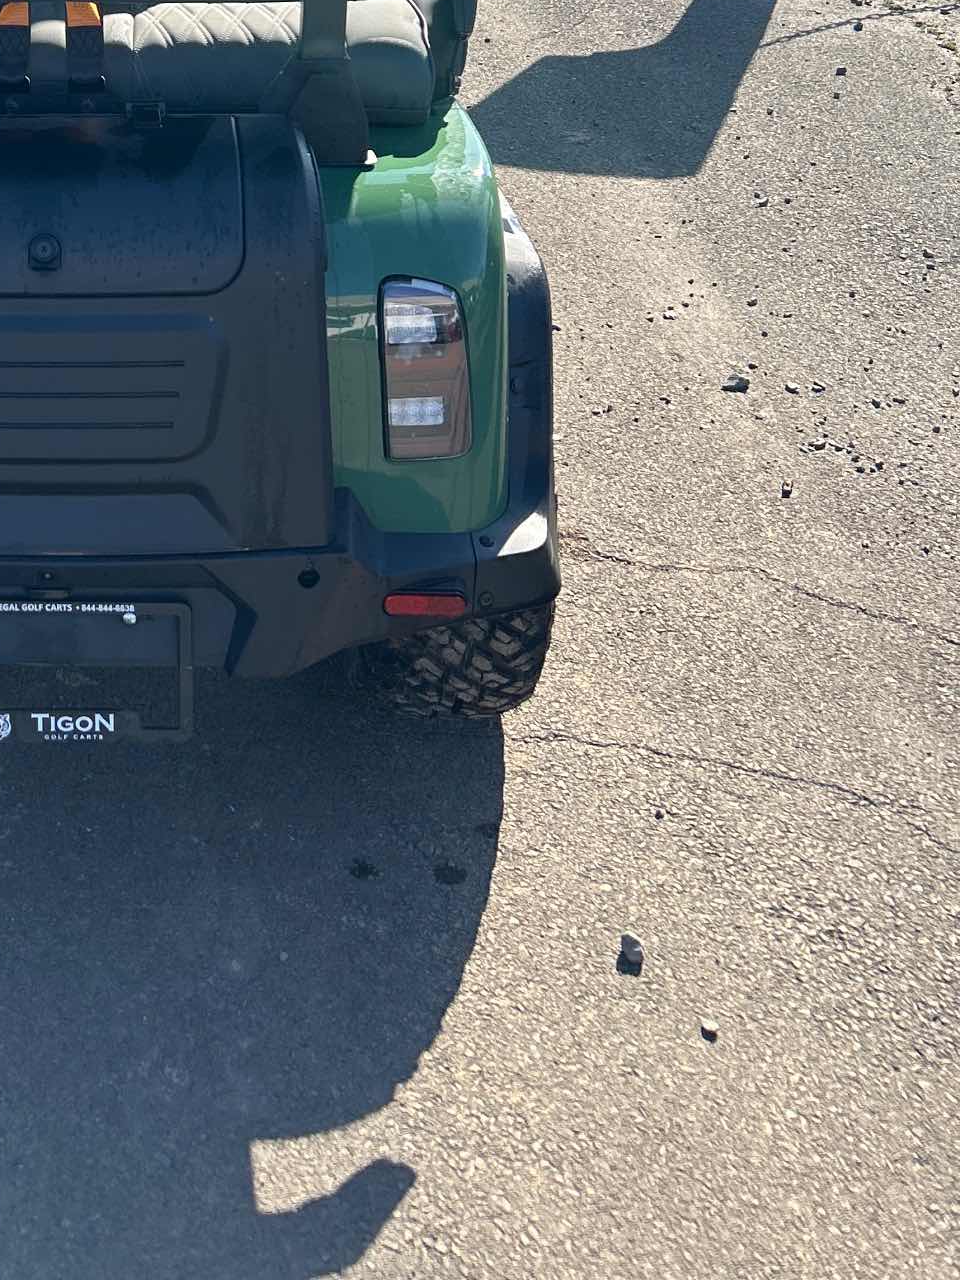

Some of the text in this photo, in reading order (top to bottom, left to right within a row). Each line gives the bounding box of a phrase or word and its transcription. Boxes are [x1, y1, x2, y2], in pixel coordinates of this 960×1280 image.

[21, 603, 43, 611] GOLF
[45, 603, 72, 611] CARTS
[31, 713, 114, 732] TIGON
